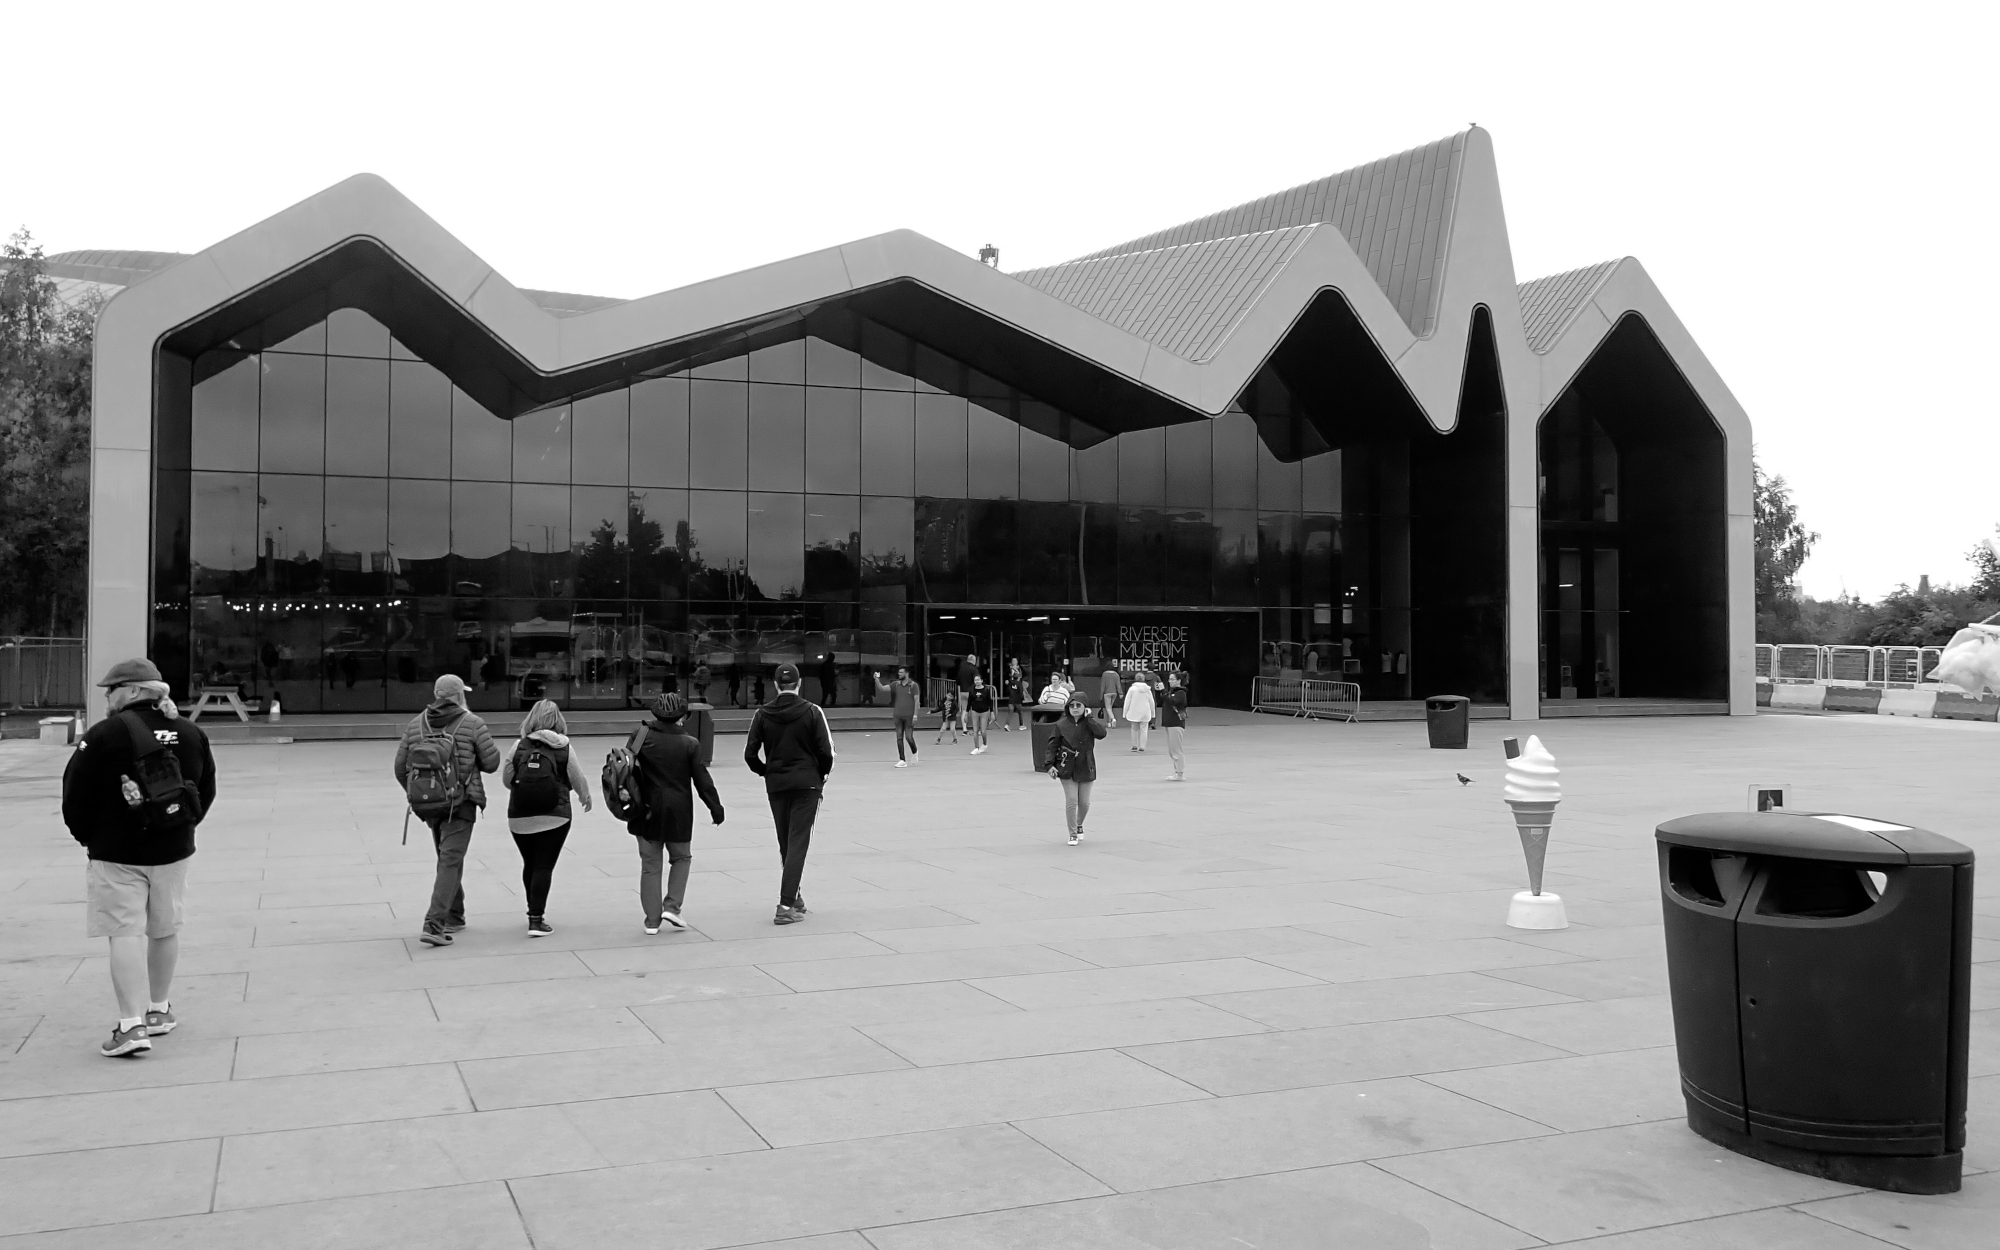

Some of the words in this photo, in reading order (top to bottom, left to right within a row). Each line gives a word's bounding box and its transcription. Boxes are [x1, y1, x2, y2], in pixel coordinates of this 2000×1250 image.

[1120, 626, 1188, 642] RIVERSIDE
[1120, 642, 1185, 659] MUSEUM
[1120, 659, 1149, 672] FREE
